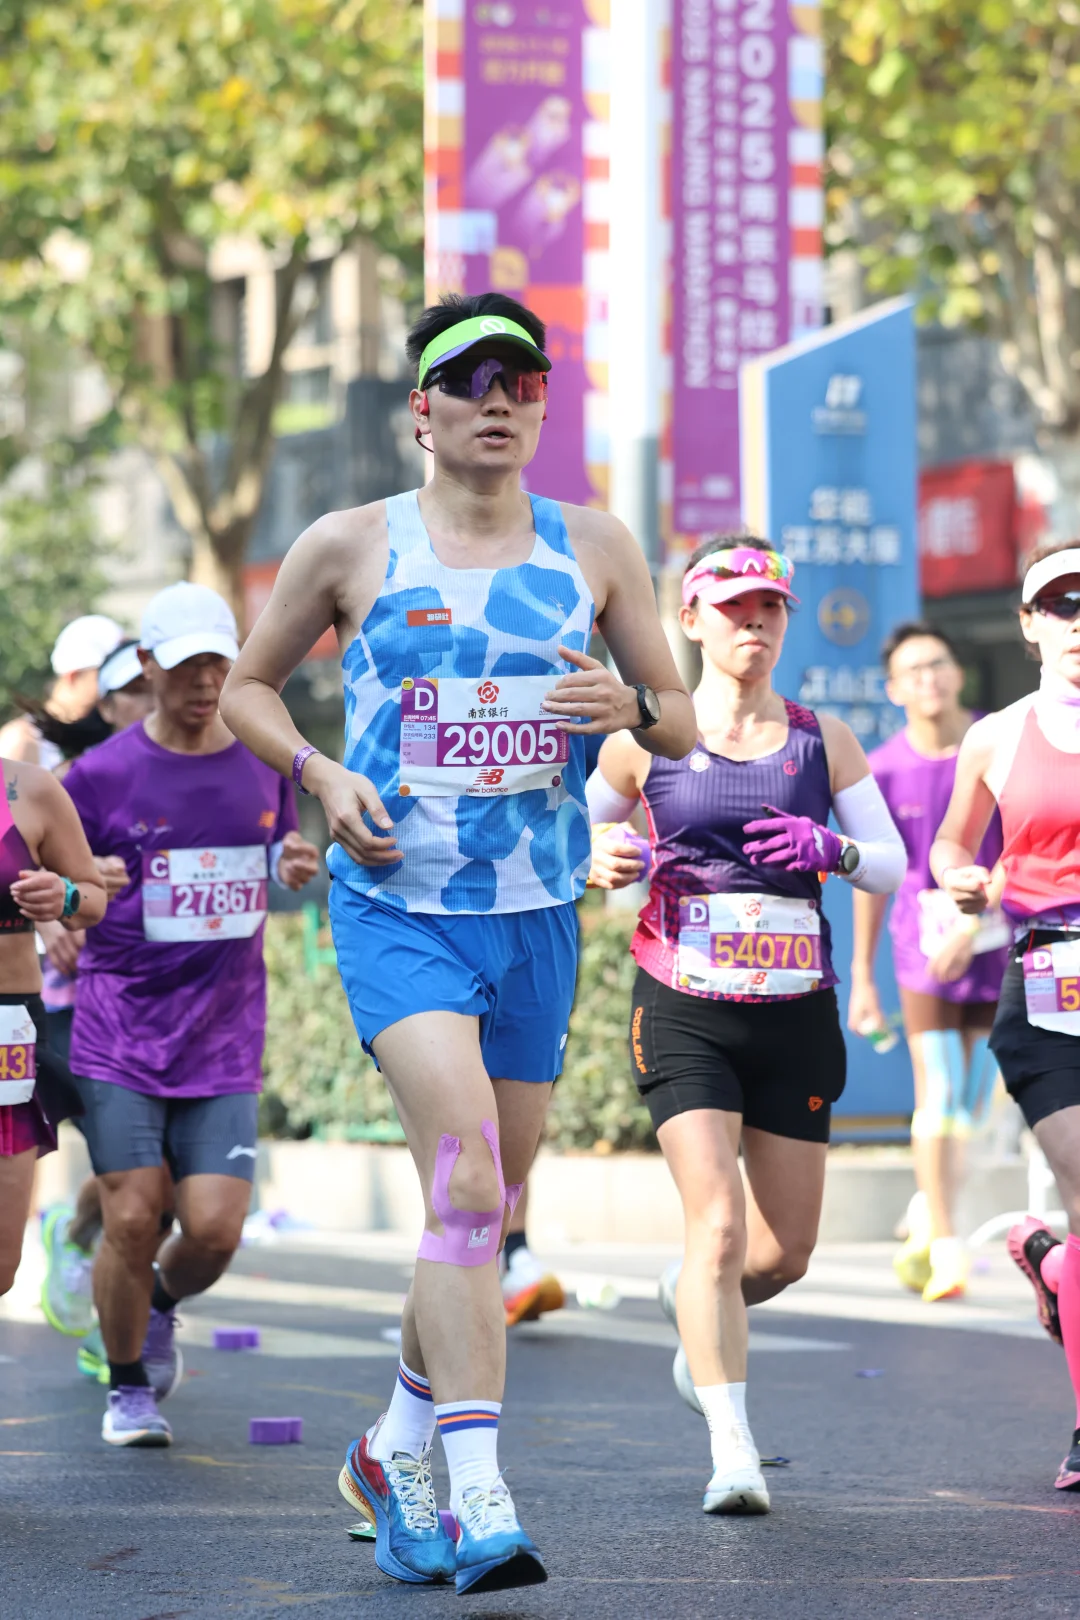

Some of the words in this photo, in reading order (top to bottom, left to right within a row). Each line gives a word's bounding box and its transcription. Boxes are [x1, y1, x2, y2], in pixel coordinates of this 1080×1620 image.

[414, 687, 435, 711] D
[468, 706, 509, 719] 南京银行
[442, 722, 559, 765] 29005
[150, 857, 169, 878] C
[175, 882, 261, 917] 27867
[689, 903, 708, 924] D
[715, 933, 813, 969] 54070
[1033, 951, 1053, 971] D
